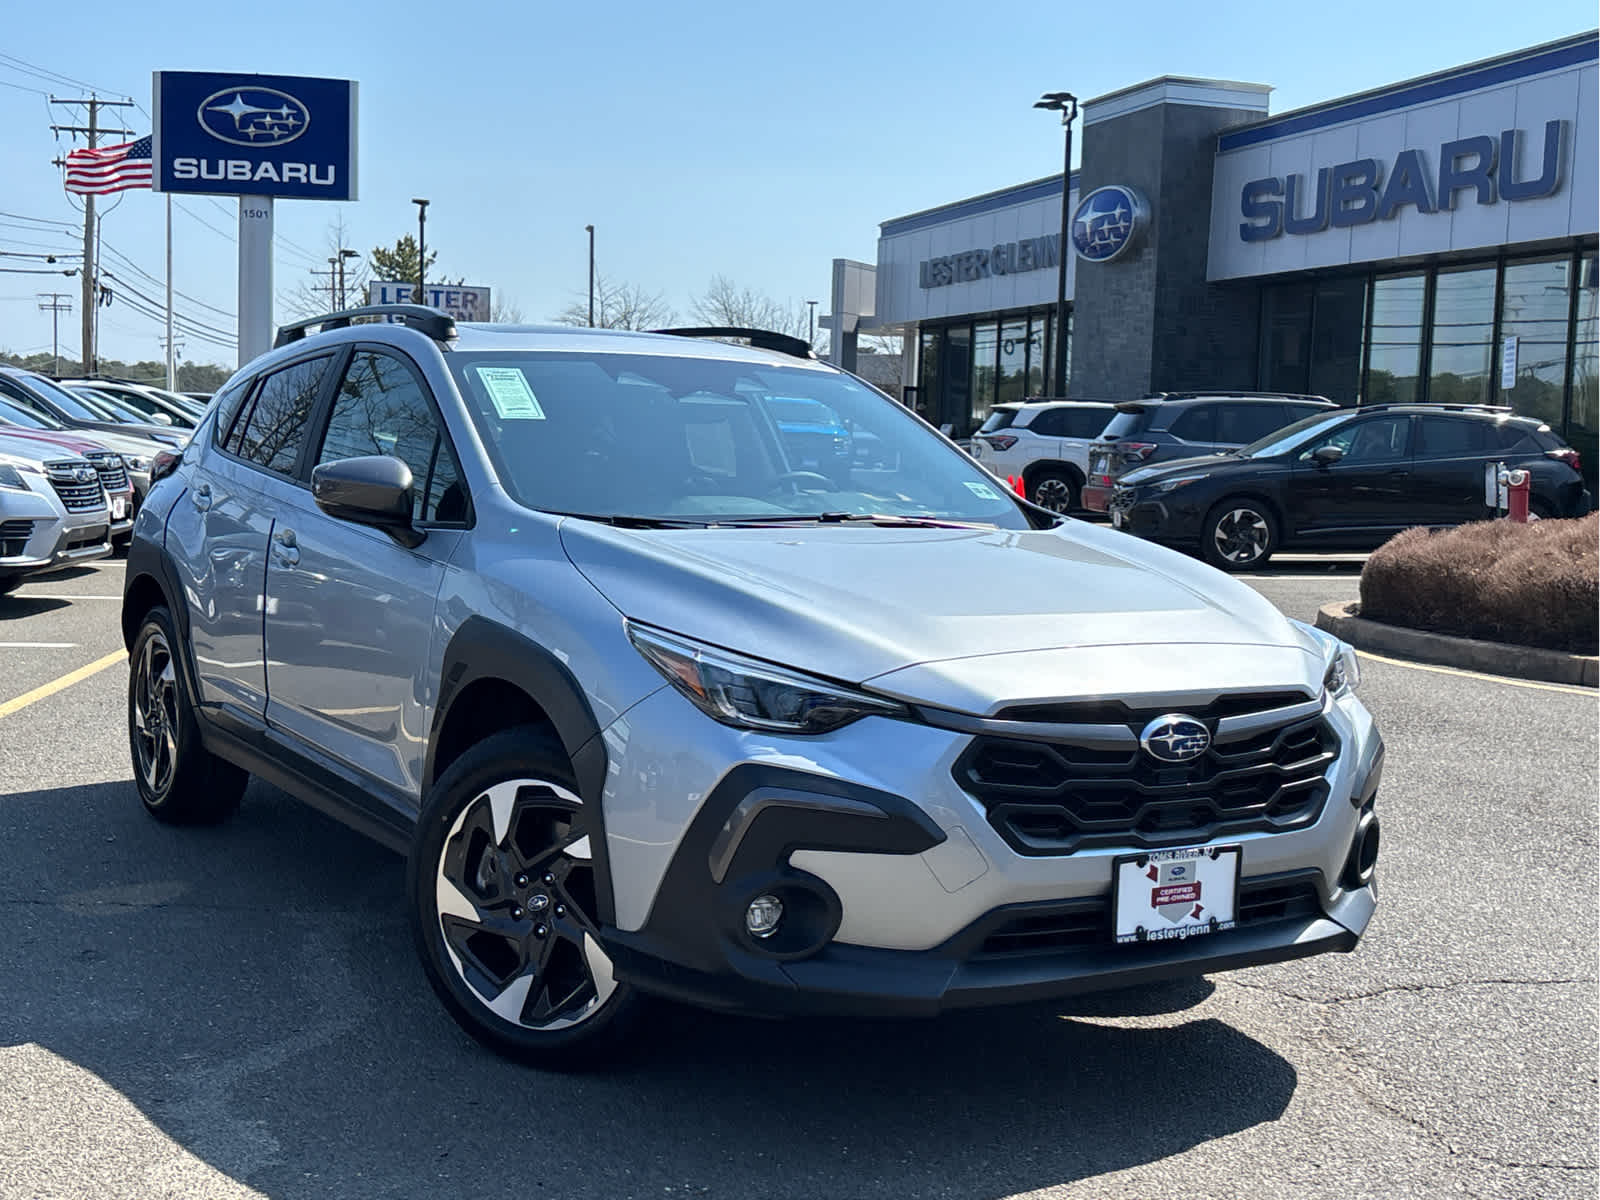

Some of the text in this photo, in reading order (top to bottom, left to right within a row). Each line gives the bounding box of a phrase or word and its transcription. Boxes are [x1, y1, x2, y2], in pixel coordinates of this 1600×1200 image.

[173, 157, 336, 185] SUBARU
[1239, 119, 1567, 243] SUBARU
[243, 209, 269, 219] 1501
[919, 233, 1062, 289] LESTER GLENN
[380, 286, 479, 309] LETER
[1156, 892, 1196, 903] PRE-OWNED
[1160, 887, 1193, 896] CERTIFIED
[1147, 924, 1210, 941] lesterglenn
